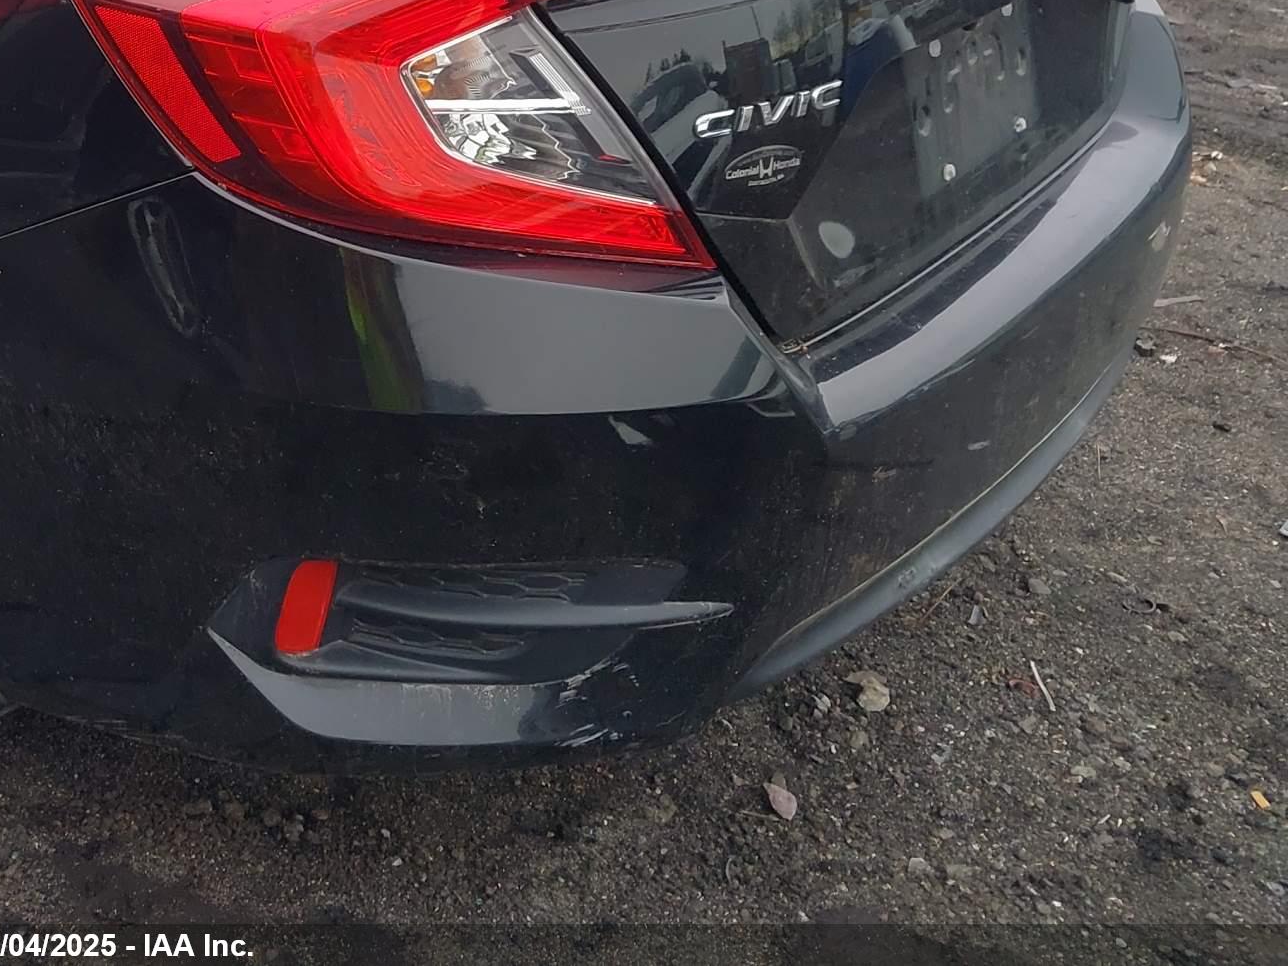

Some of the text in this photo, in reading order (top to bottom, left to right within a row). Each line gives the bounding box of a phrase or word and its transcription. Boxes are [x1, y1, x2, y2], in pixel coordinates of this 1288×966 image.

[695, 79, 843, 139] CIVIC
[725, 164, 760, 180] Colonial
[773, 157, 801, 171] Honda
